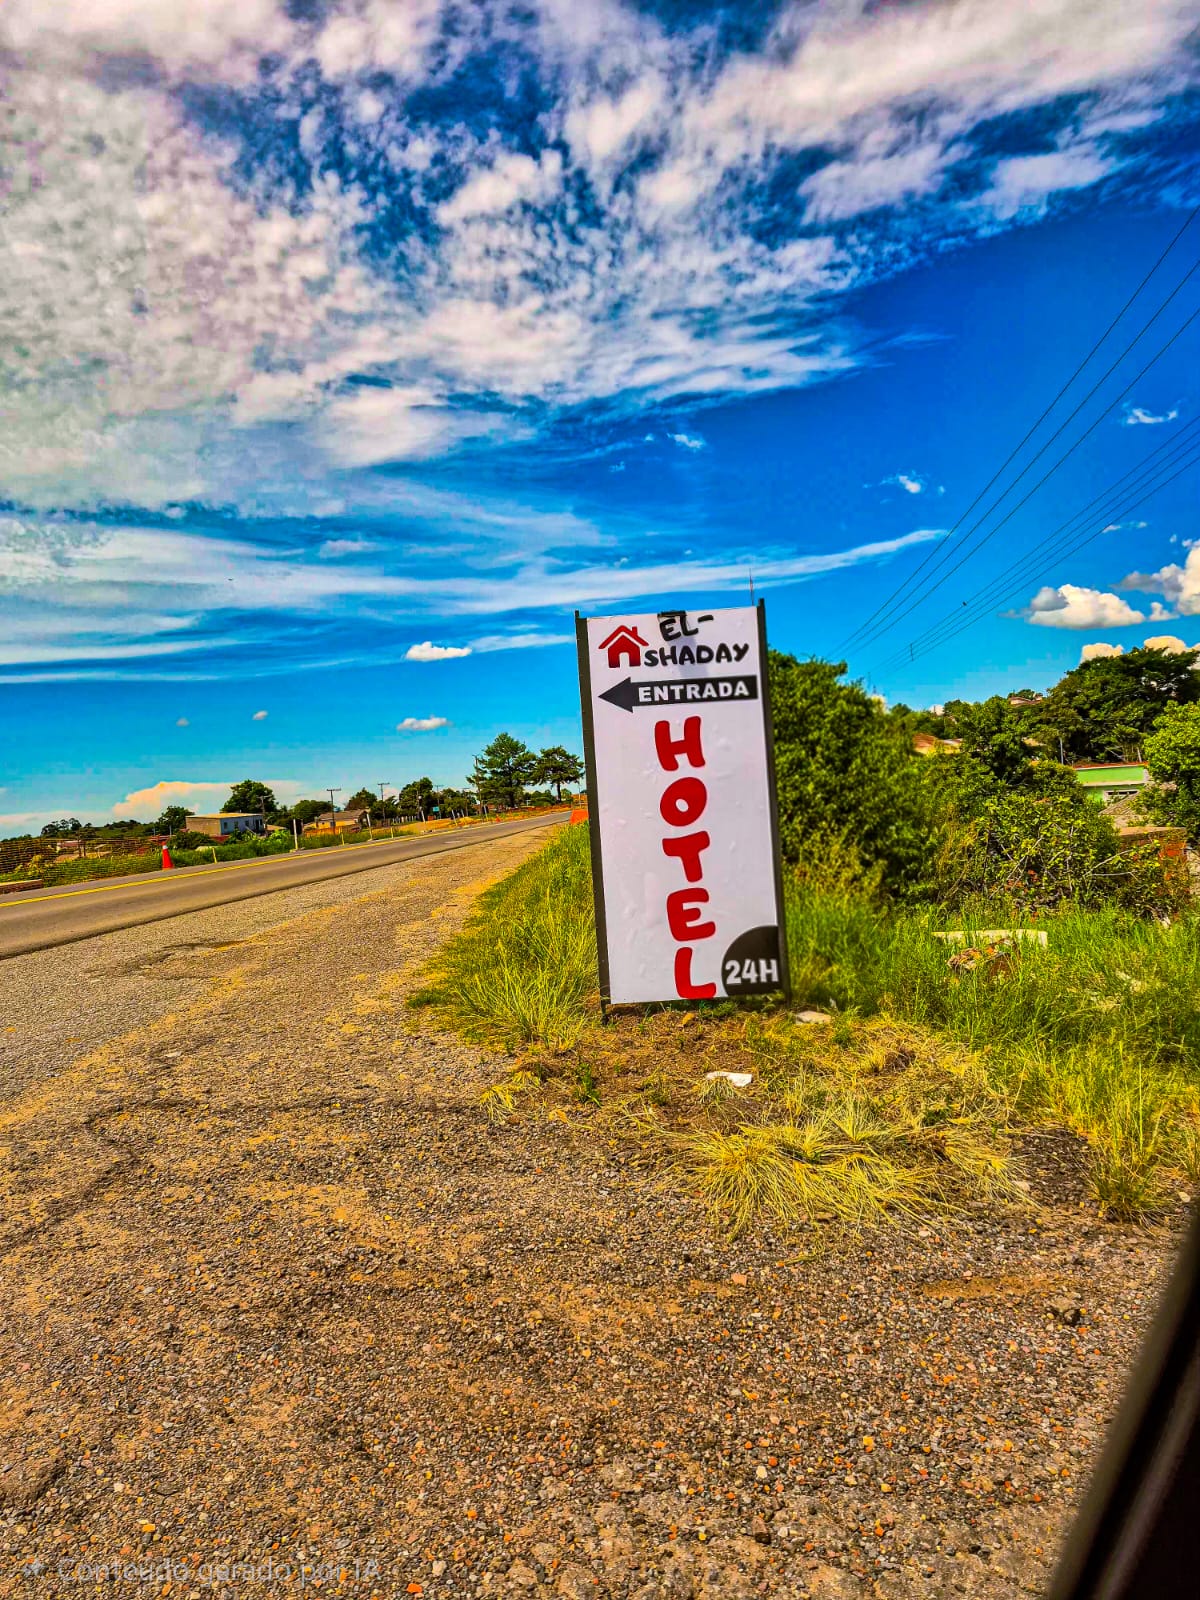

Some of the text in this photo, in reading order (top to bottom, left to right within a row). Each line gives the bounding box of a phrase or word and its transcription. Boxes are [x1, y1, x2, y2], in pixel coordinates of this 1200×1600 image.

[644, 643, 749, 667] SHADAY
[638, 681, 749, 702] ENTRADA
[654, 716, 717, 999] HOTEL
[725, 960, 778, 985] 24H
